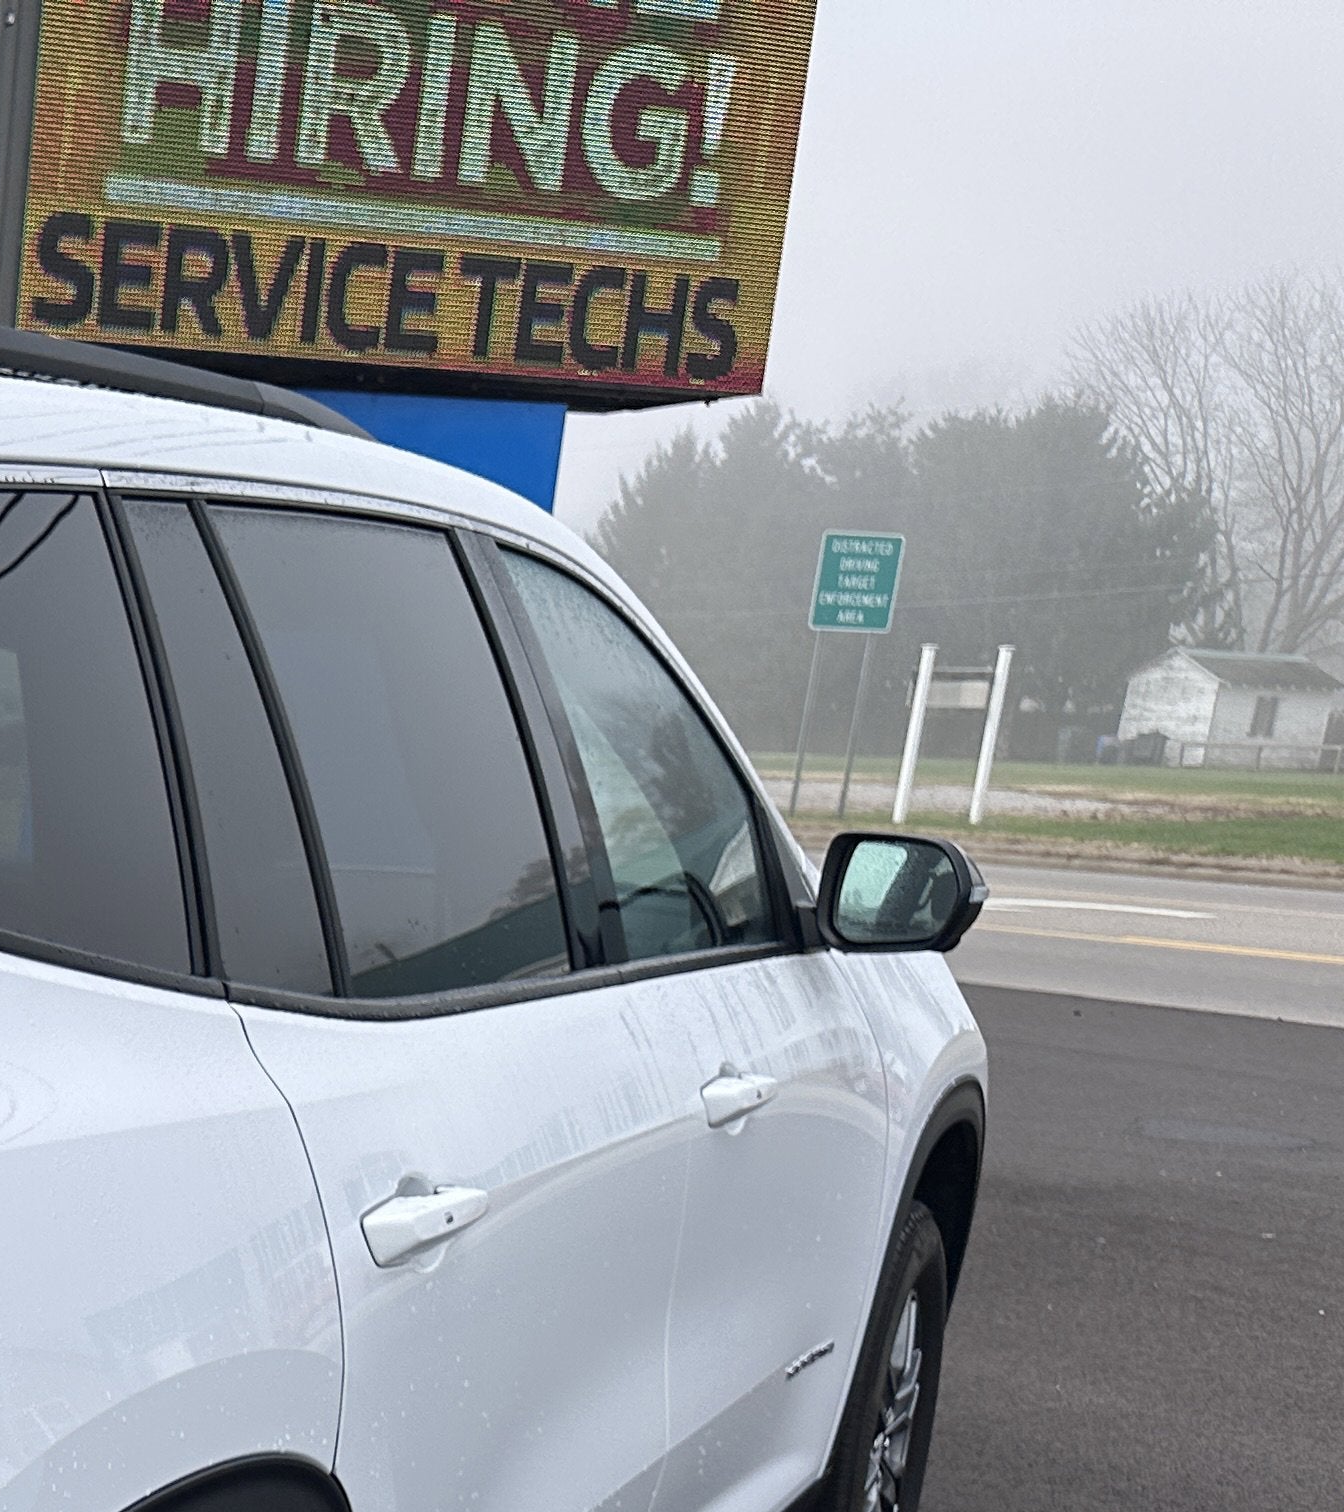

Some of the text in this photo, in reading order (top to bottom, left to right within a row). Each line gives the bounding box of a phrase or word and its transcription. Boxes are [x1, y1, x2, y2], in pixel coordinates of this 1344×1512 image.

[120, 0, 738, 206] HIRING!
[32, 211, 740, 384] SERVICE TECHS
[831, 539, 894, 556] DISTRACTED
[839, 556, 880, 573] DRIVING
[837, 573, 876, 590] TARGET
[818, 591, 889, 608] ENFORCEMENT
[836, 607, 864, 624] AREA
